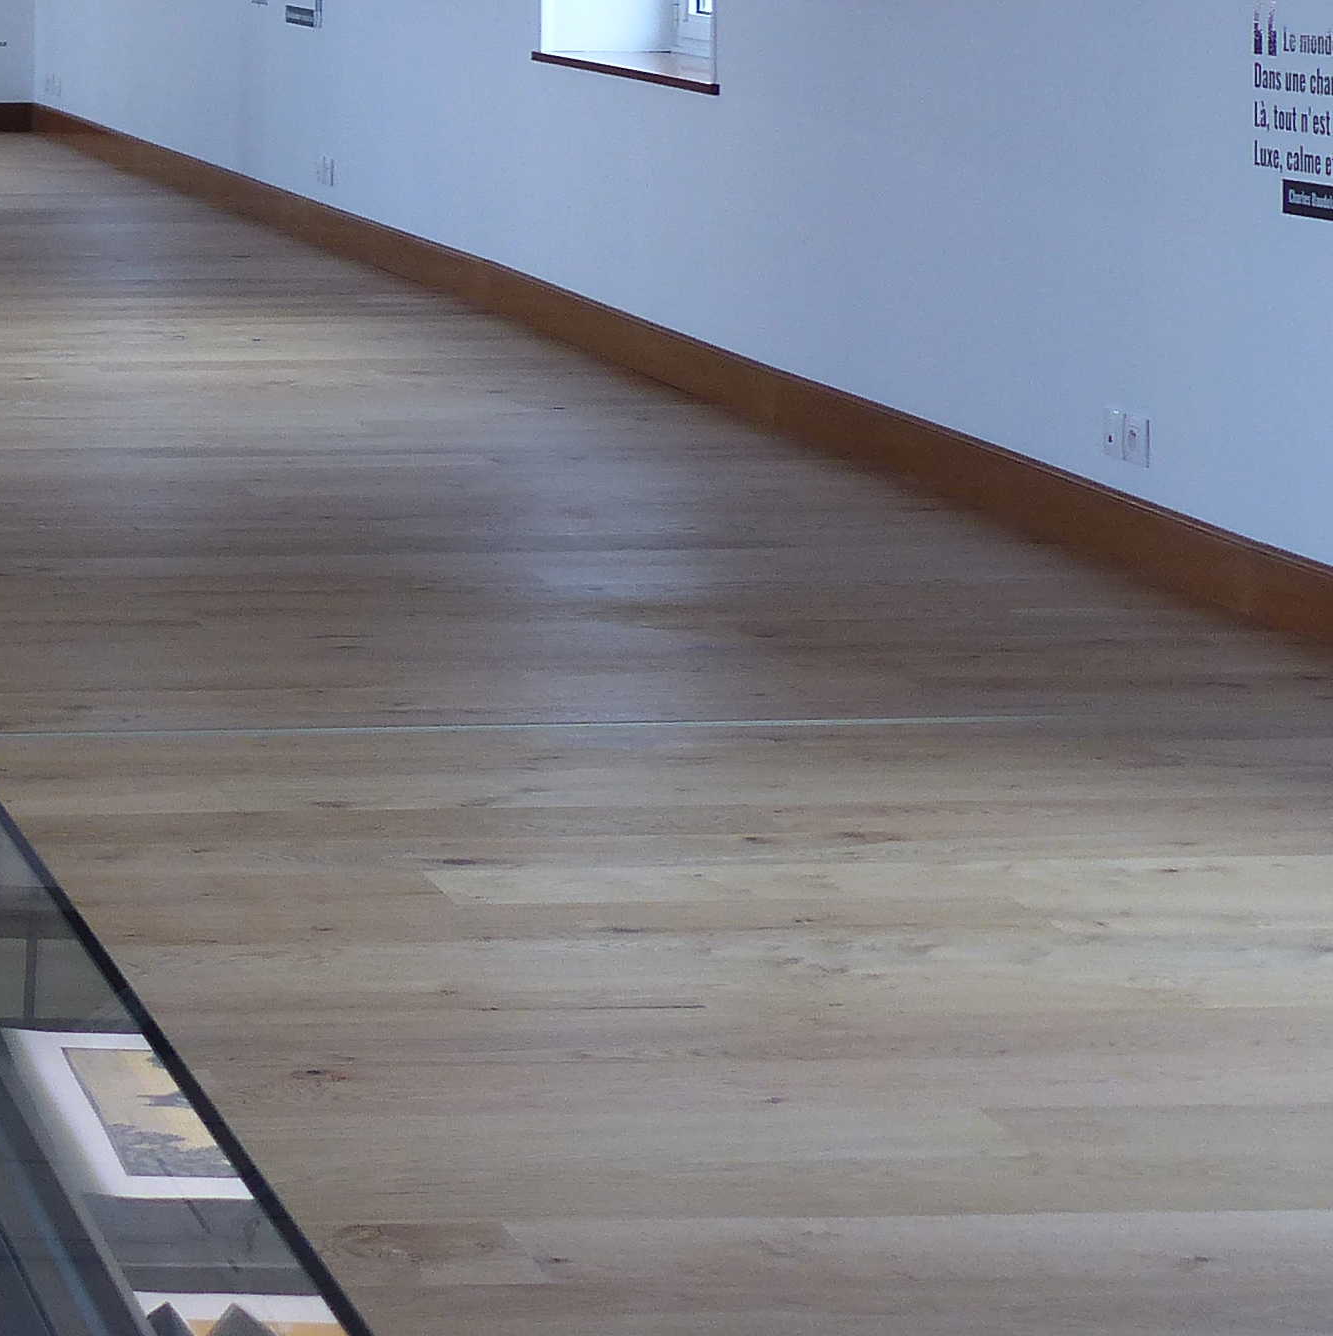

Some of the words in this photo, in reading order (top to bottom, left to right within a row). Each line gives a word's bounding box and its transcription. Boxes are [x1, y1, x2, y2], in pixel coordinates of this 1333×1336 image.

[1283, 26, 1296, 54] Le
[1299, 28, 1333, 56] mond
[1254, 62, 1281, 91] Dans
[1285, 72, 1307, 94] une
[1254, 100, 1270, 132] Là,
[1274, 104, 1297, 133] tout
[1301, 107, 1331, 136] n'est
[1254, 140, 1283, 173] Luxe,
[1286, 145, 1321, 176] calme
